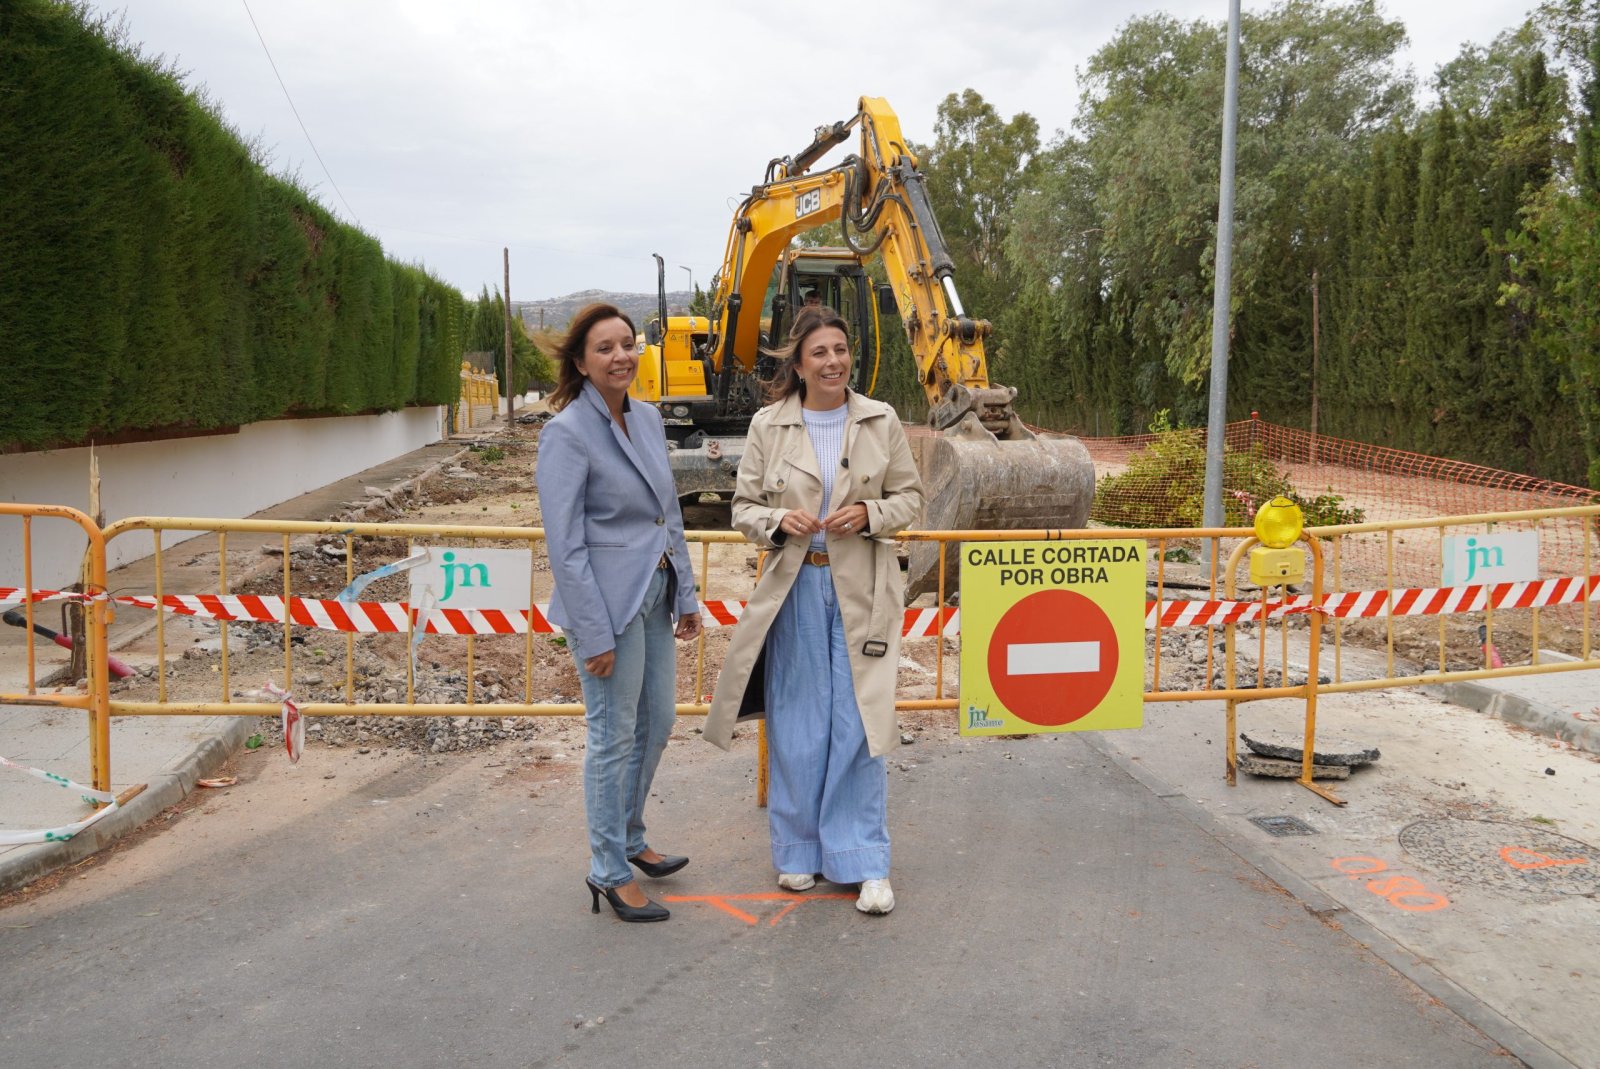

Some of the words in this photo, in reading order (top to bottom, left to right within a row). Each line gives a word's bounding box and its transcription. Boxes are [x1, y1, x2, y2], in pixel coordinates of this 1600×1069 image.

[795, 188, 820, 218] JCB
[968, 548, 1035, 566] CALLE
[1041, 546, 1140, 564] CORTADA
[1464, 537, 1505, 582] jm
[438, 551, 492, 602] jm
[1000, 568, 1044, 586] POR
[1050, 567, 1109, 585] OBRA
